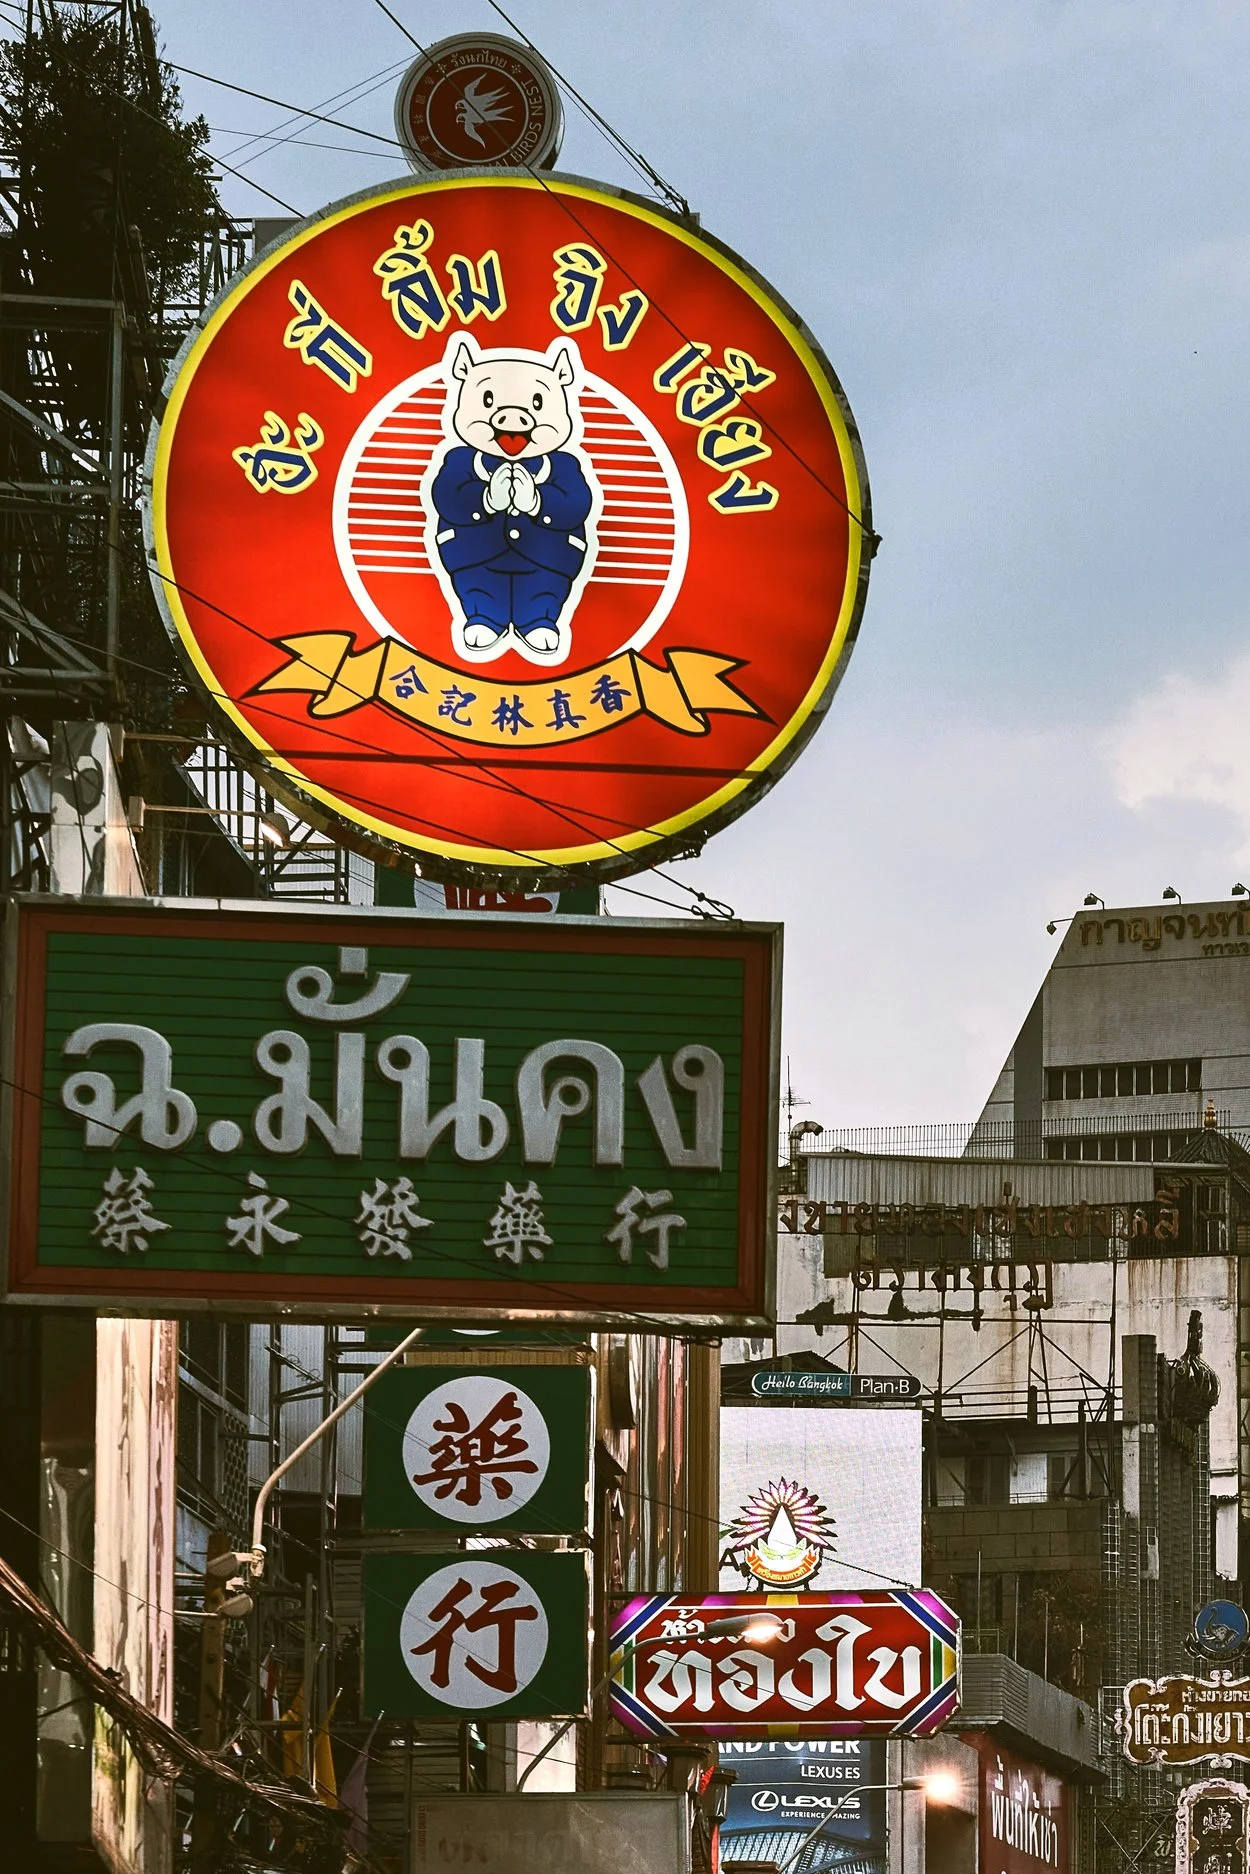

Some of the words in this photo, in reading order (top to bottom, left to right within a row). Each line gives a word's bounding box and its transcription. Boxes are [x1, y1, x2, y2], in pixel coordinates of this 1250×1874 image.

[520, 78, 544, 117] NEST
[514, 121, 543, 163] BIRDS
[373, 218, 507, 340] ลิ้ม
[60, 946, 725, 1172] ฉ.มั่นคง
[643, 1614, 923, 1713] ทองใบ
[801, 1765, 842, 1778] LEXUS
[845, 1767, 860, 1779] ES
[781, 1795, 861, 1809] LEXUS
[781, 1811, 826, 1819] EXPERIENCE
